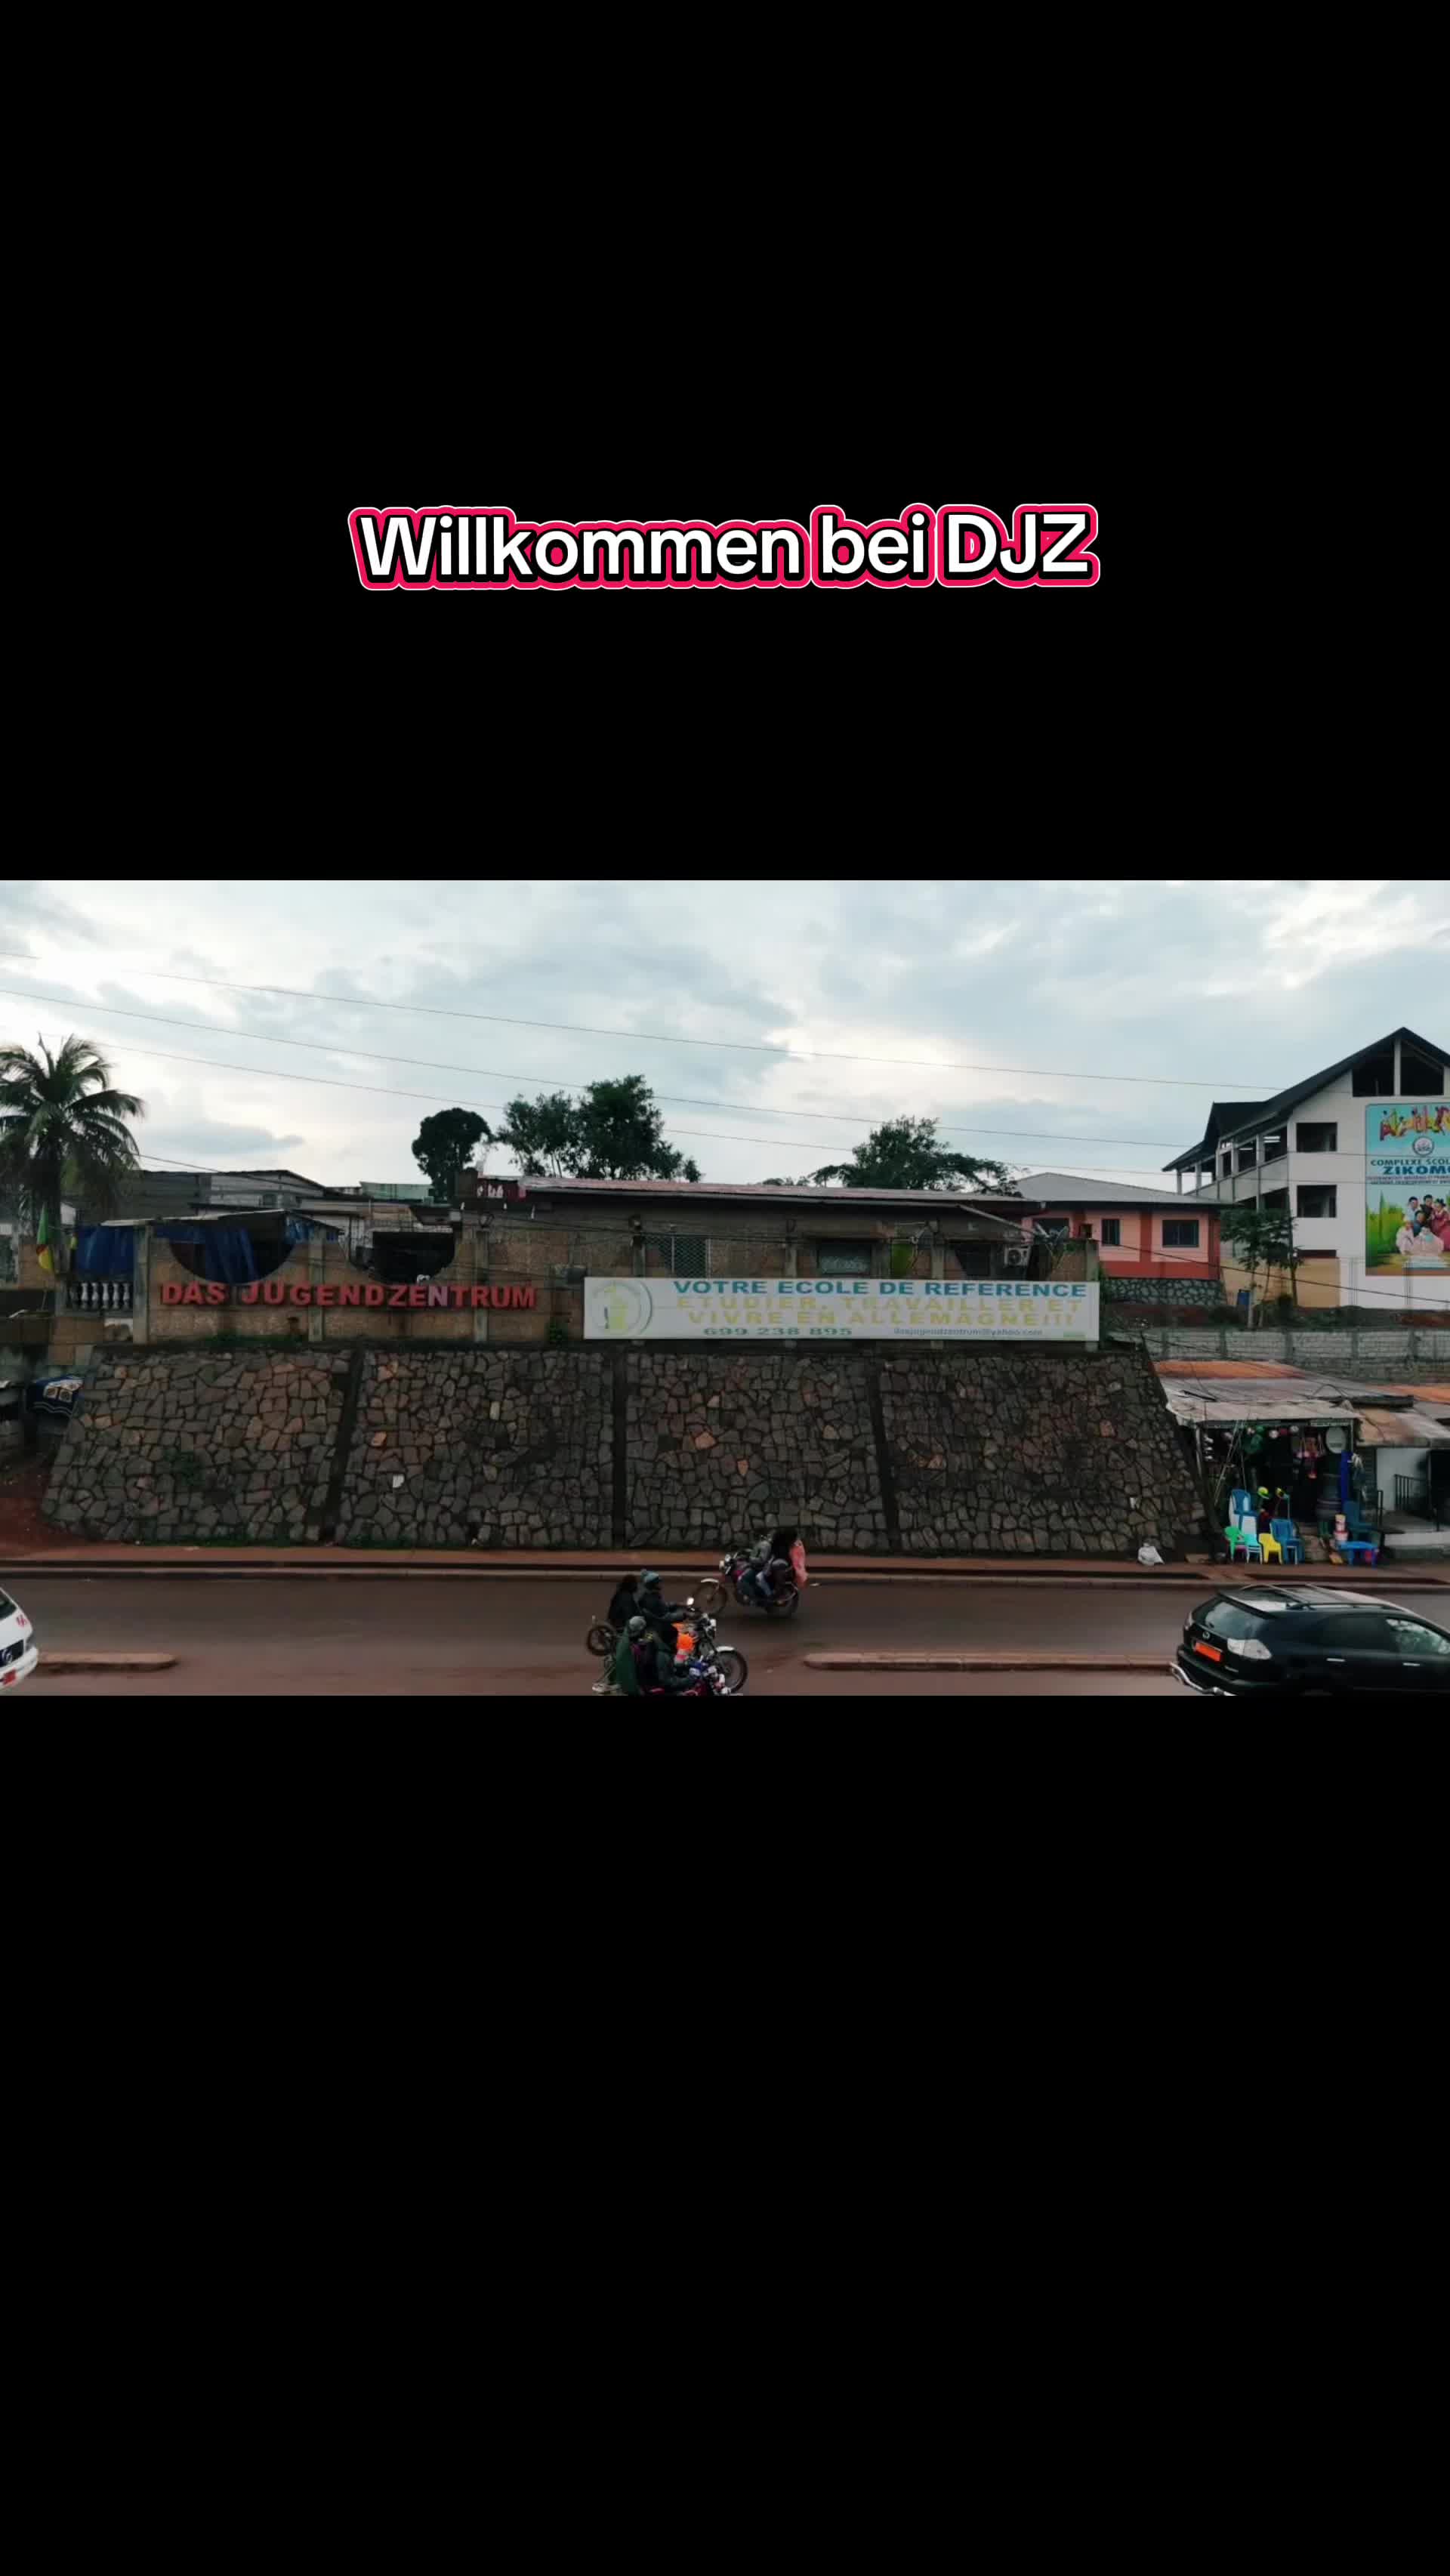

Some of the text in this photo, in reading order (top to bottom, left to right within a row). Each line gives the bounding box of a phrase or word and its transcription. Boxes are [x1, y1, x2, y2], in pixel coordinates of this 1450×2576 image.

[1383, 1166, 1450, 1175] ZIKOM
[161, 1282, 536, 1308] DAS JUGENDZENTRUM
[674, 1280, 1086, 1297] VOTRE ECOLE DE REFERENCE
[843, 1297, 1035, 1312] TRAVAILLER
[1048, 1299, 1083, 1313] ET
[688, 1311, 783, 1325] VIVRE
[797, 1312, 837, 1326] EN
[703, 1327, 853, 1336] 699 238 895
